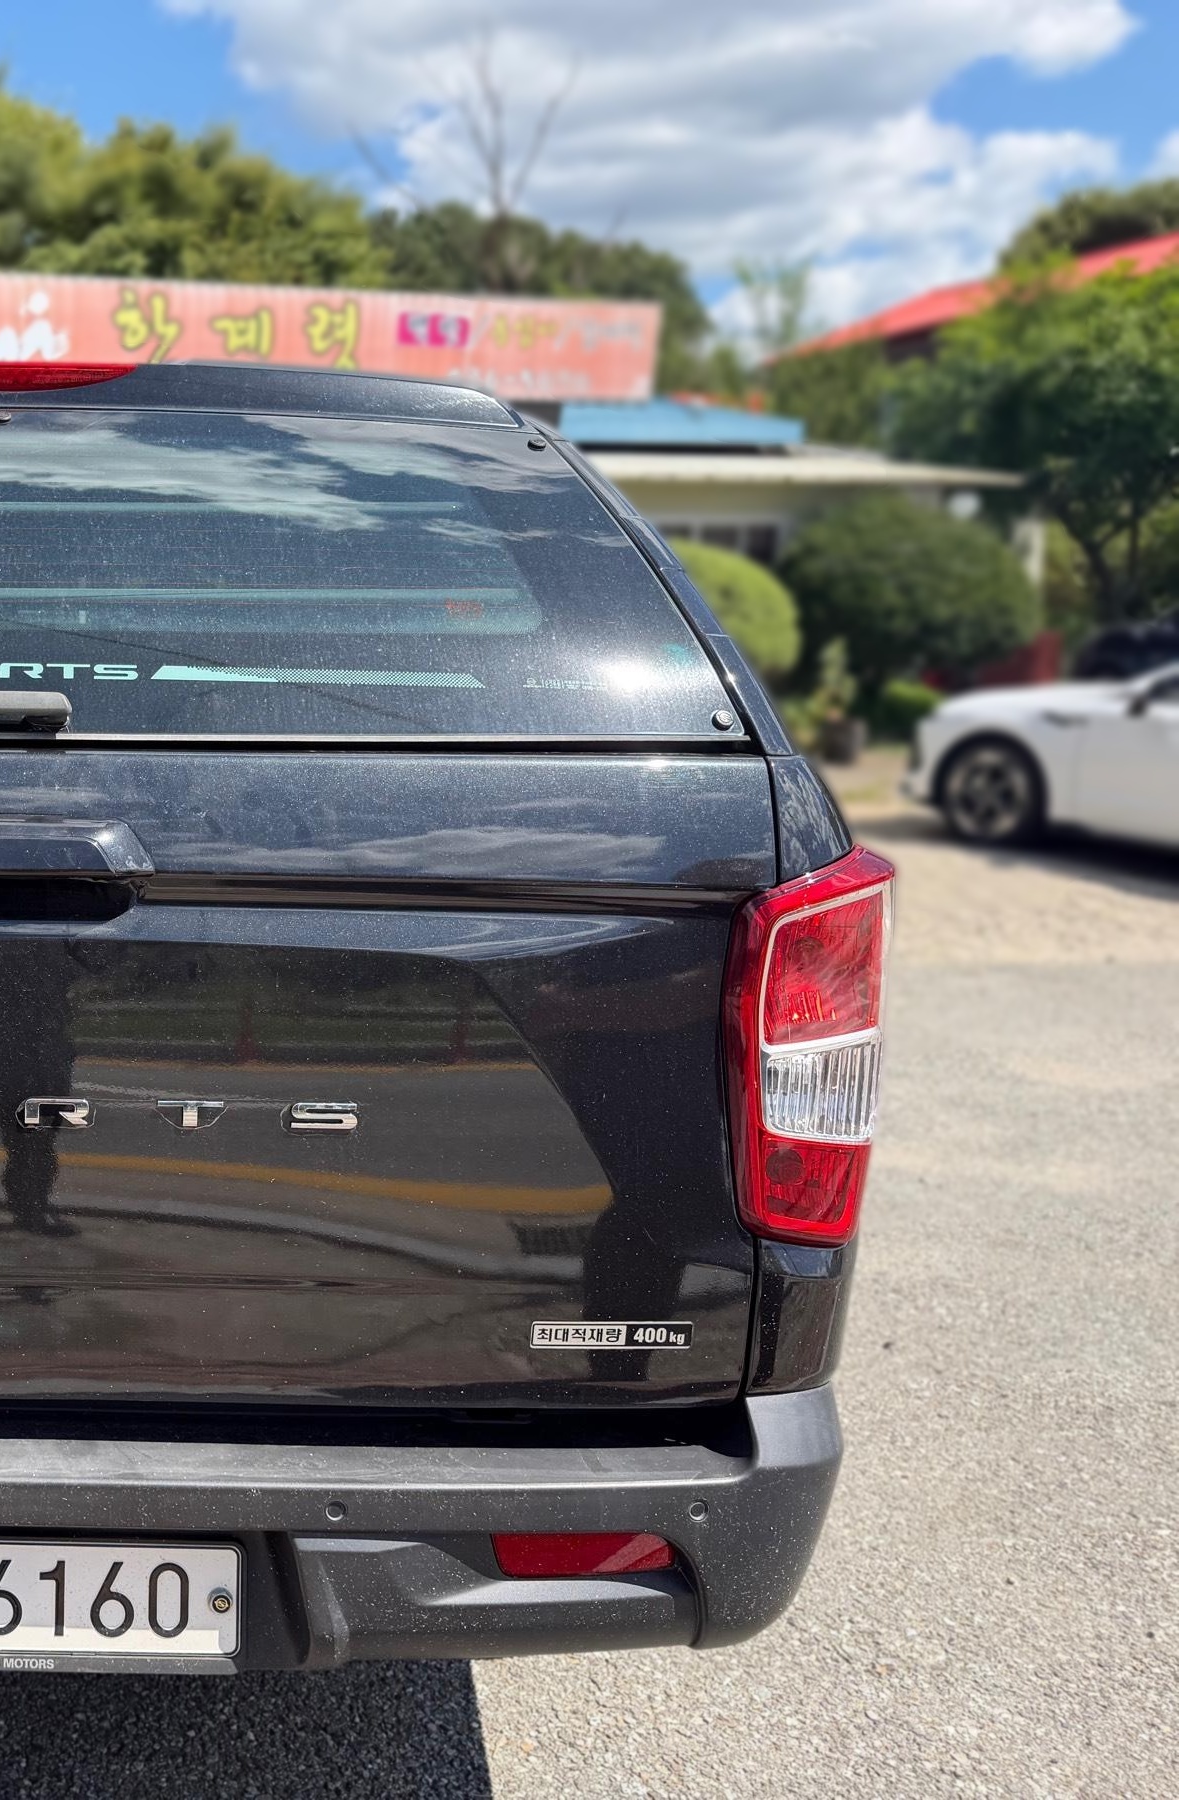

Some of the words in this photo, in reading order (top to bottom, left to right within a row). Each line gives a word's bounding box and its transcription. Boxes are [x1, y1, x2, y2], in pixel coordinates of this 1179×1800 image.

[537, 1328, 622, 1343] 최대적재량
[633, 1327, 667, 1343] 400
[669, 1332, 685, 1345] kg
[3, 1657, 55, 1670] MOTORS
